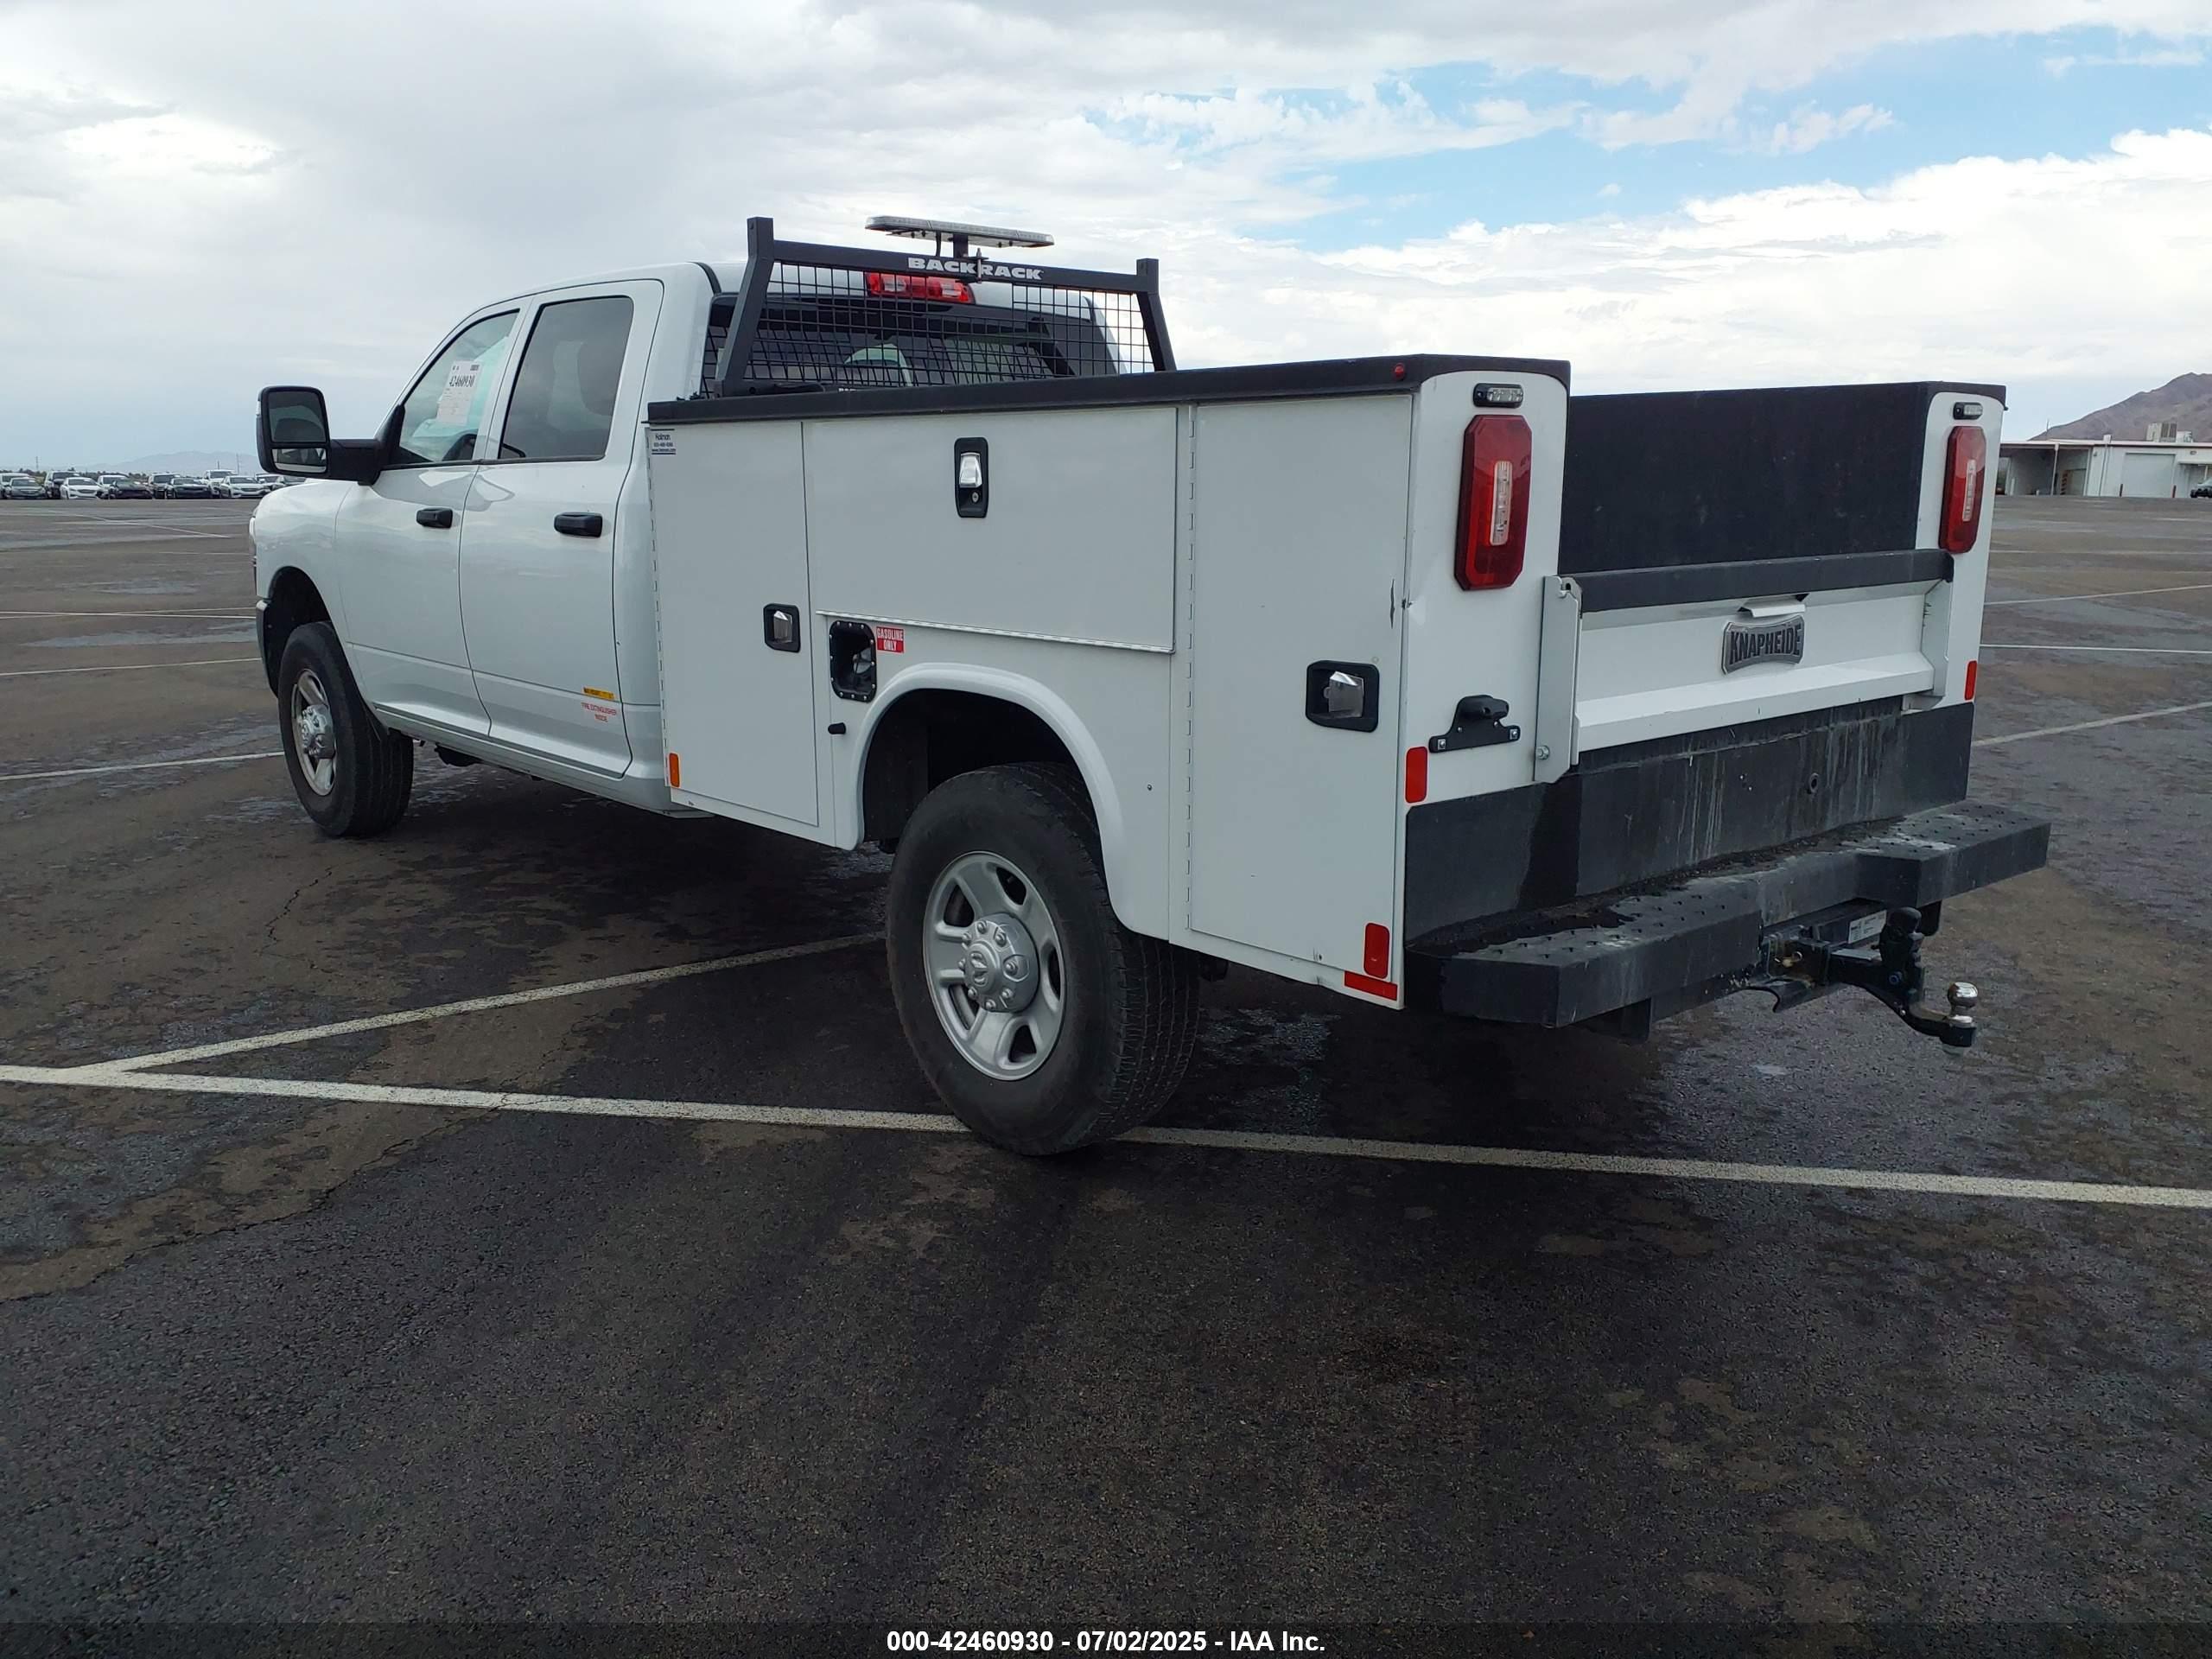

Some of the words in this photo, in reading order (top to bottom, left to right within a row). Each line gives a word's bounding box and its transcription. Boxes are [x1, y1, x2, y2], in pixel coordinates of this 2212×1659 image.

[908, 257, 1042, 280] BACKRACK
[877, 627, 903, 641] GASOLINE
[883, 639, 897, 652] ONLY
[1729, 622, 1802, 665] KNAPHEIDE
